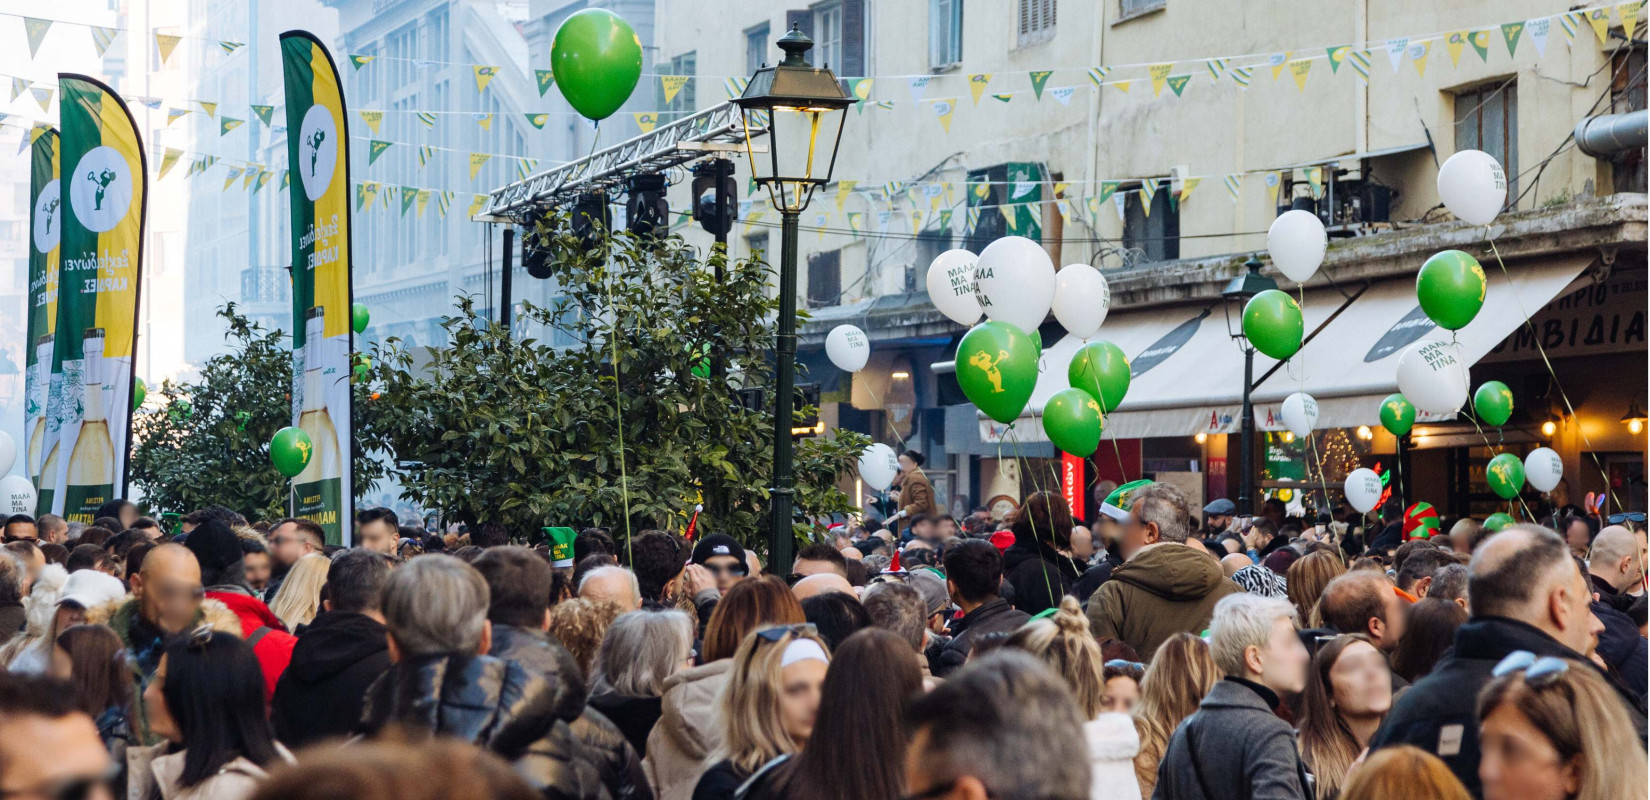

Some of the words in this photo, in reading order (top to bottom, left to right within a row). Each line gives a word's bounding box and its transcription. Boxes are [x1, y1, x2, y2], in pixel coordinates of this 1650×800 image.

[947, 262, 975, 279] ΜΑΛΑ
[973, 267, 994, 281] ΑΛΑ
[950, 275, 968, 288] ΜΑ
[953, 282, 976, 297] ΤΙΝΑ
[1491, 310, 1648, 353] ΜΒΙΔΙΑ
[1423, 349, 1444, 363] ΜΑ
[1429, 355, 1457, 371] ΤΙΝΑ
